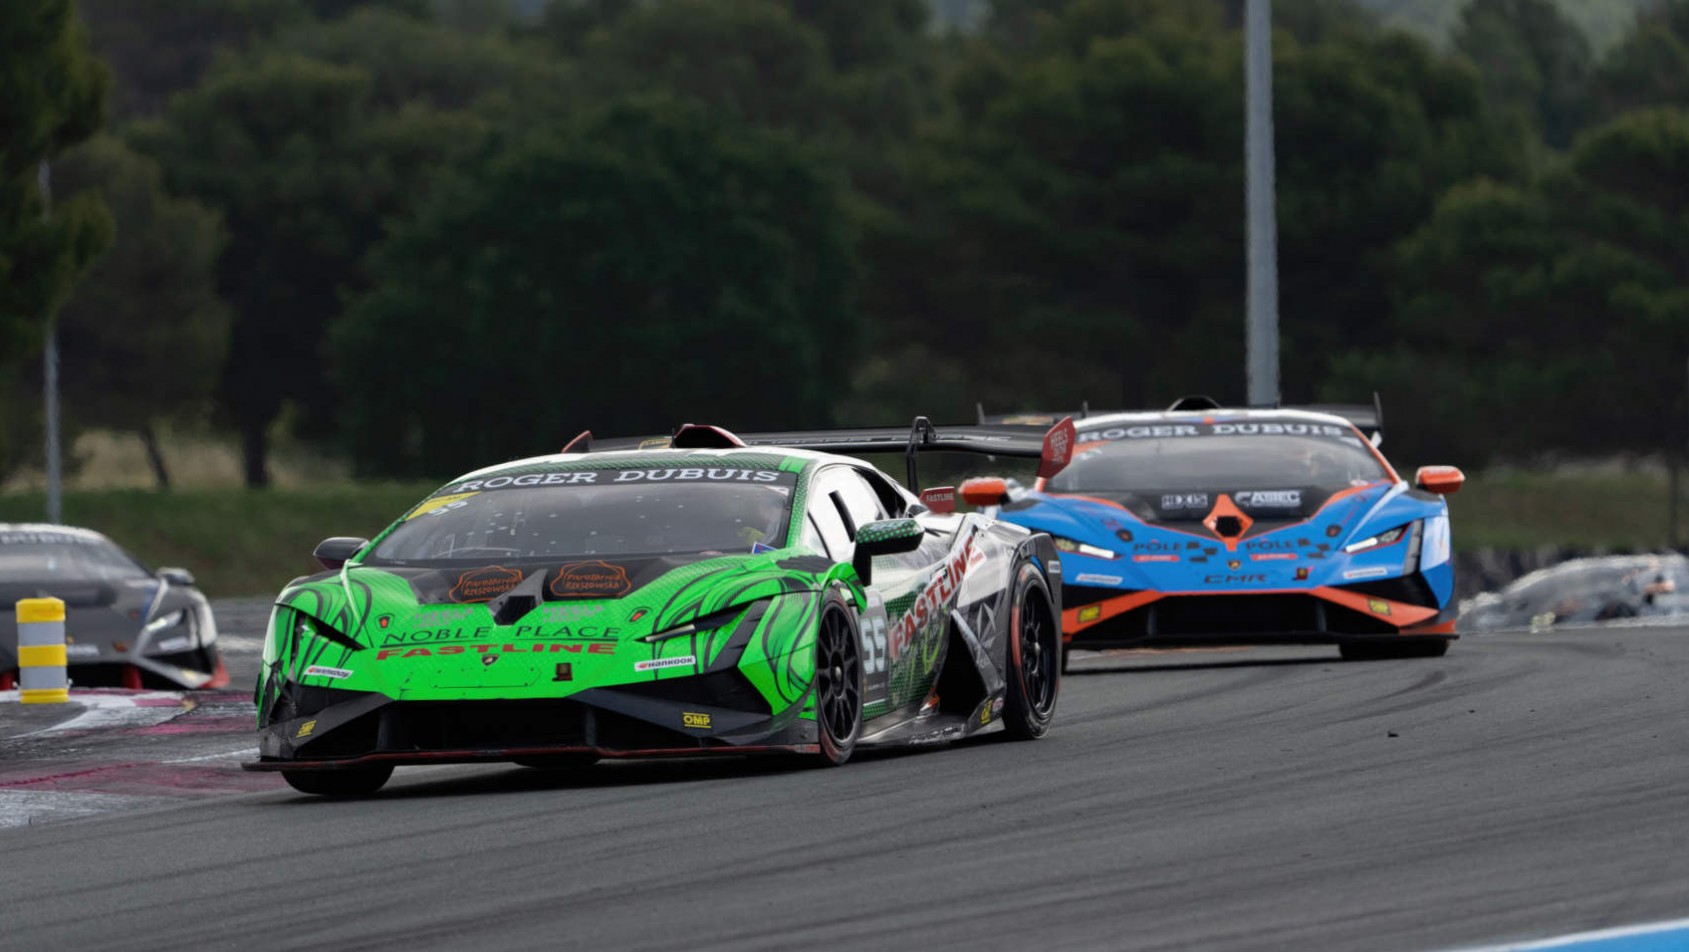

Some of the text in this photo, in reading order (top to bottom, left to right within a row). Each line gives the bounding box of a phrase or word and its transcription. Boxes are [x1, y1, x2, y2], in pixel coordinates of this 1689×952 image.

[1078, 424, 1344, 442] ROGER DUBUIS
[452, 468, 781, 493] ROGER DUBUIS
[888, 535, 984, 662] FASTLINE
[383, 626, 623, 645] NOBLE PLACE
[860, 615, 887, 675] 55
[375, 643, 618, 660] FASTLINE
[683, 713, 711, 727] OMP
